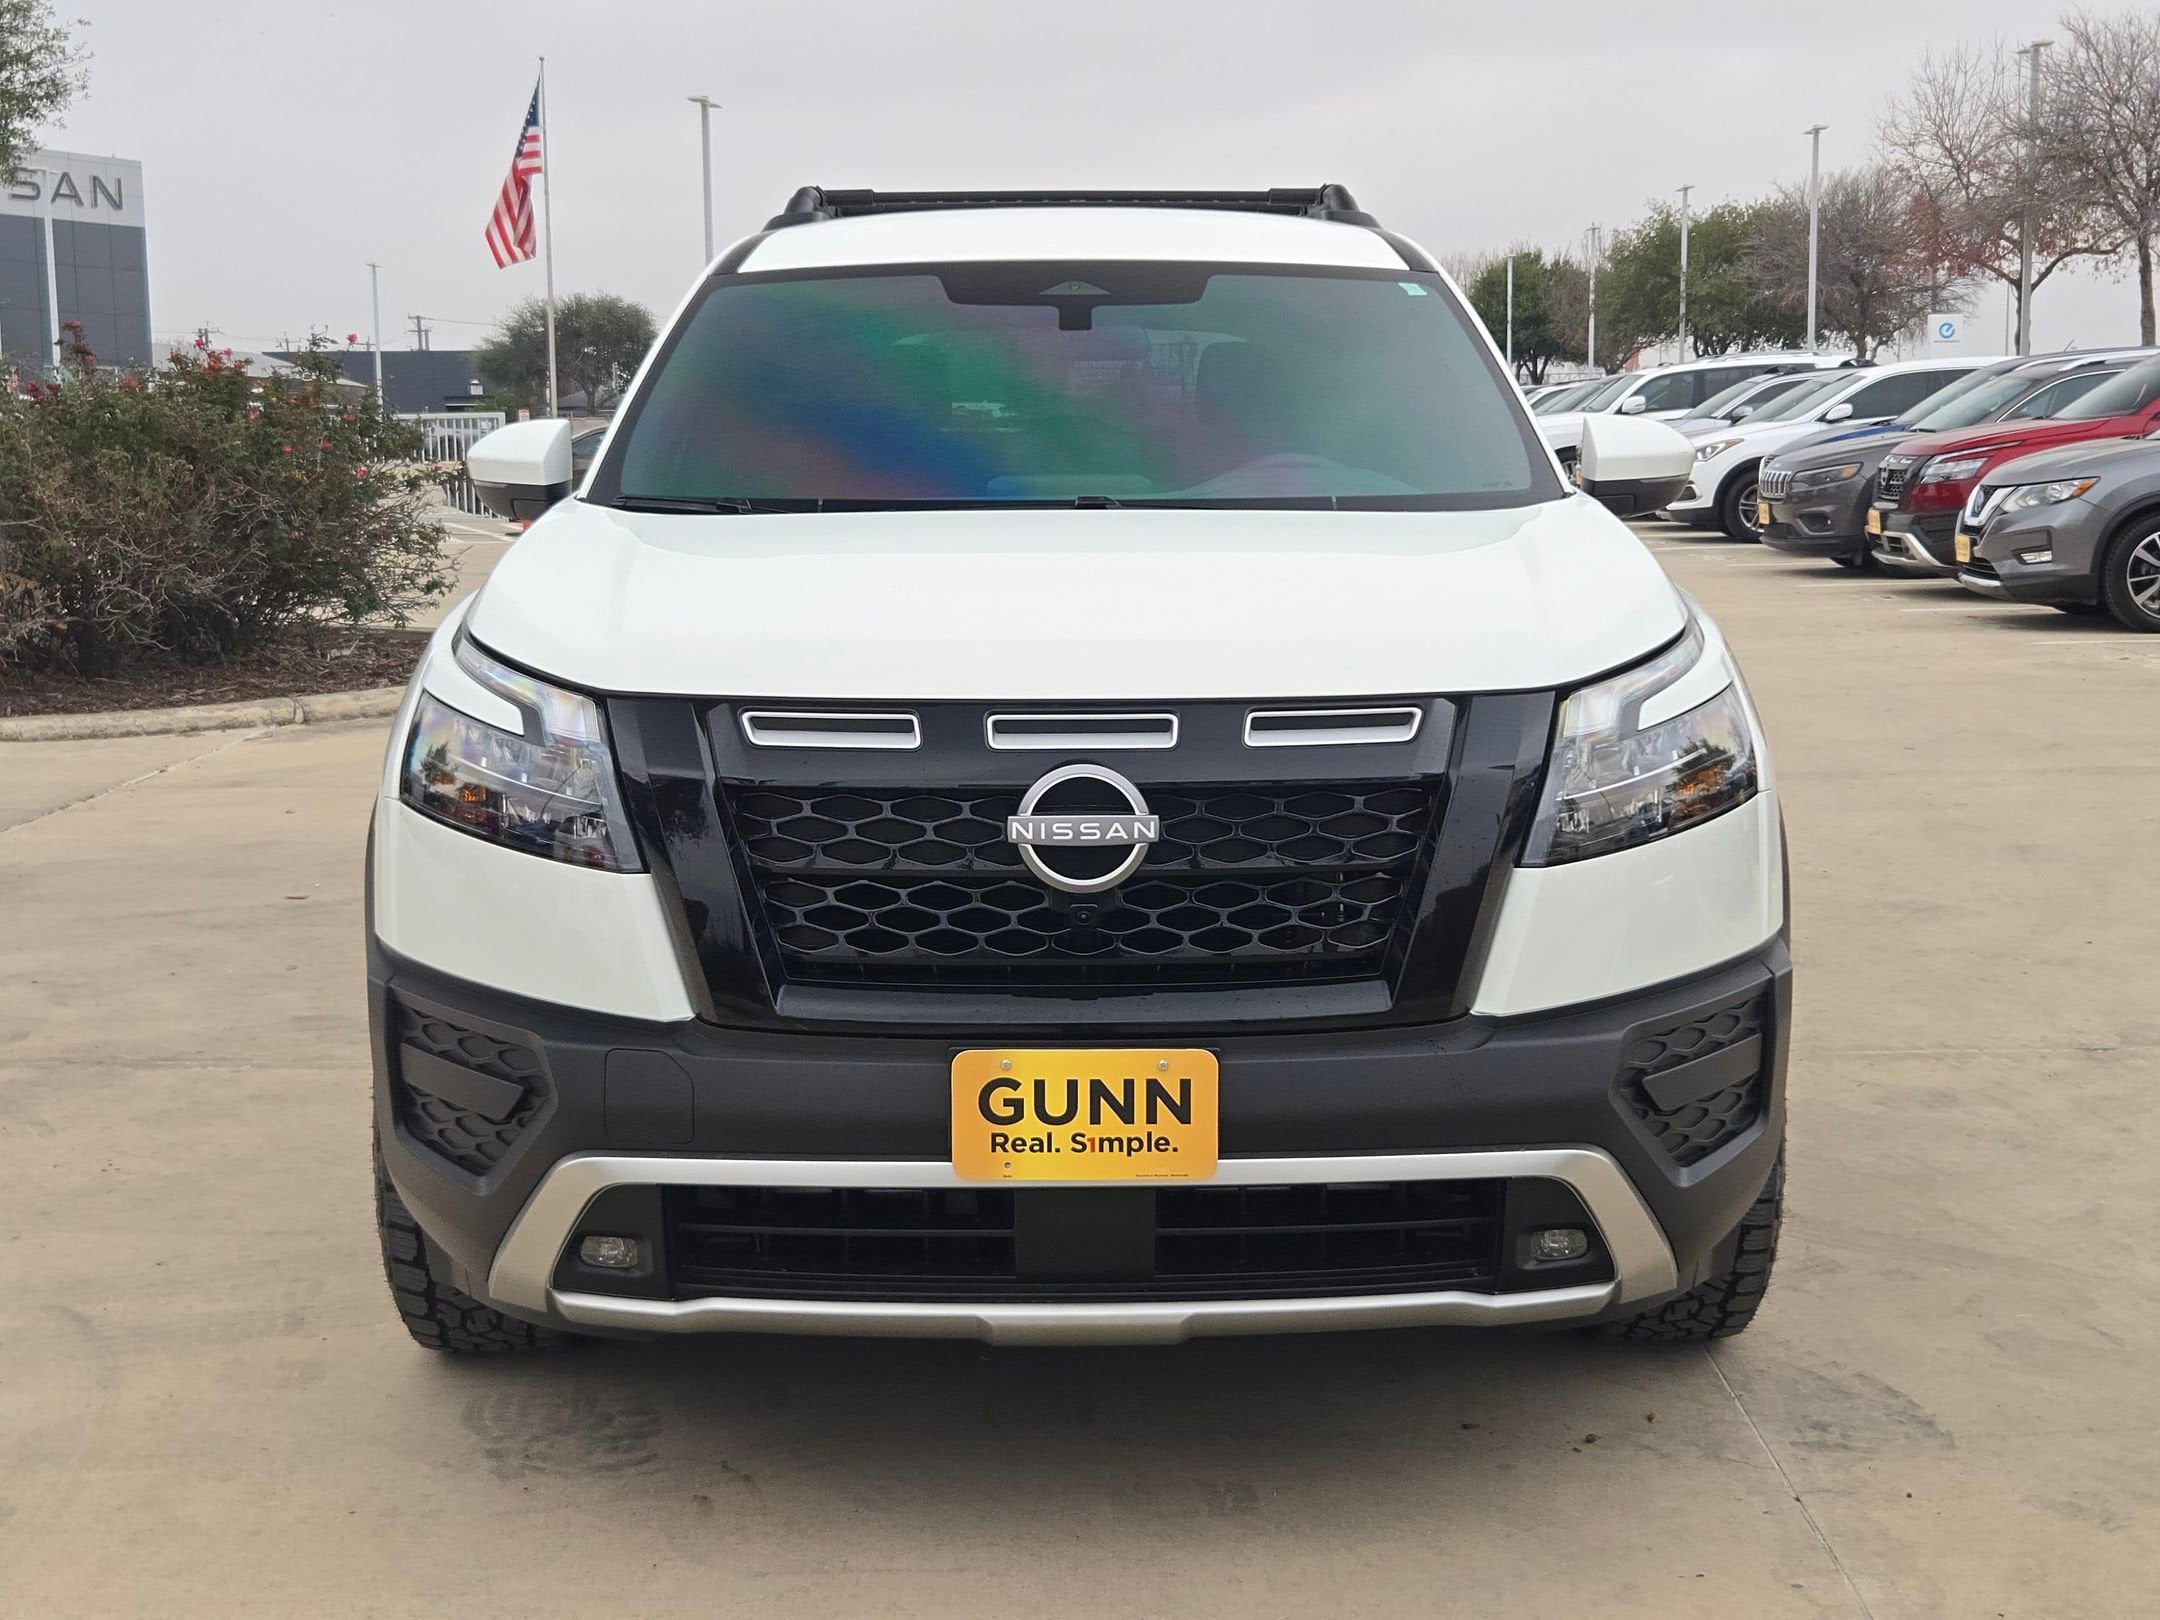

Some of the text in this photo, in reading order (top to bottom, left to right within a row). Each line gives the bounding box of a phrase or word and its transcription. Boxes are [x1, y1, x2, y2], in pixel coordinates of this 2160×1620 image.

[1011, 821, 1155, 840] NISSAN
[978, 1077, 1192, 1126] GUNN
[991, 1132, 1061, 1153] Real.
